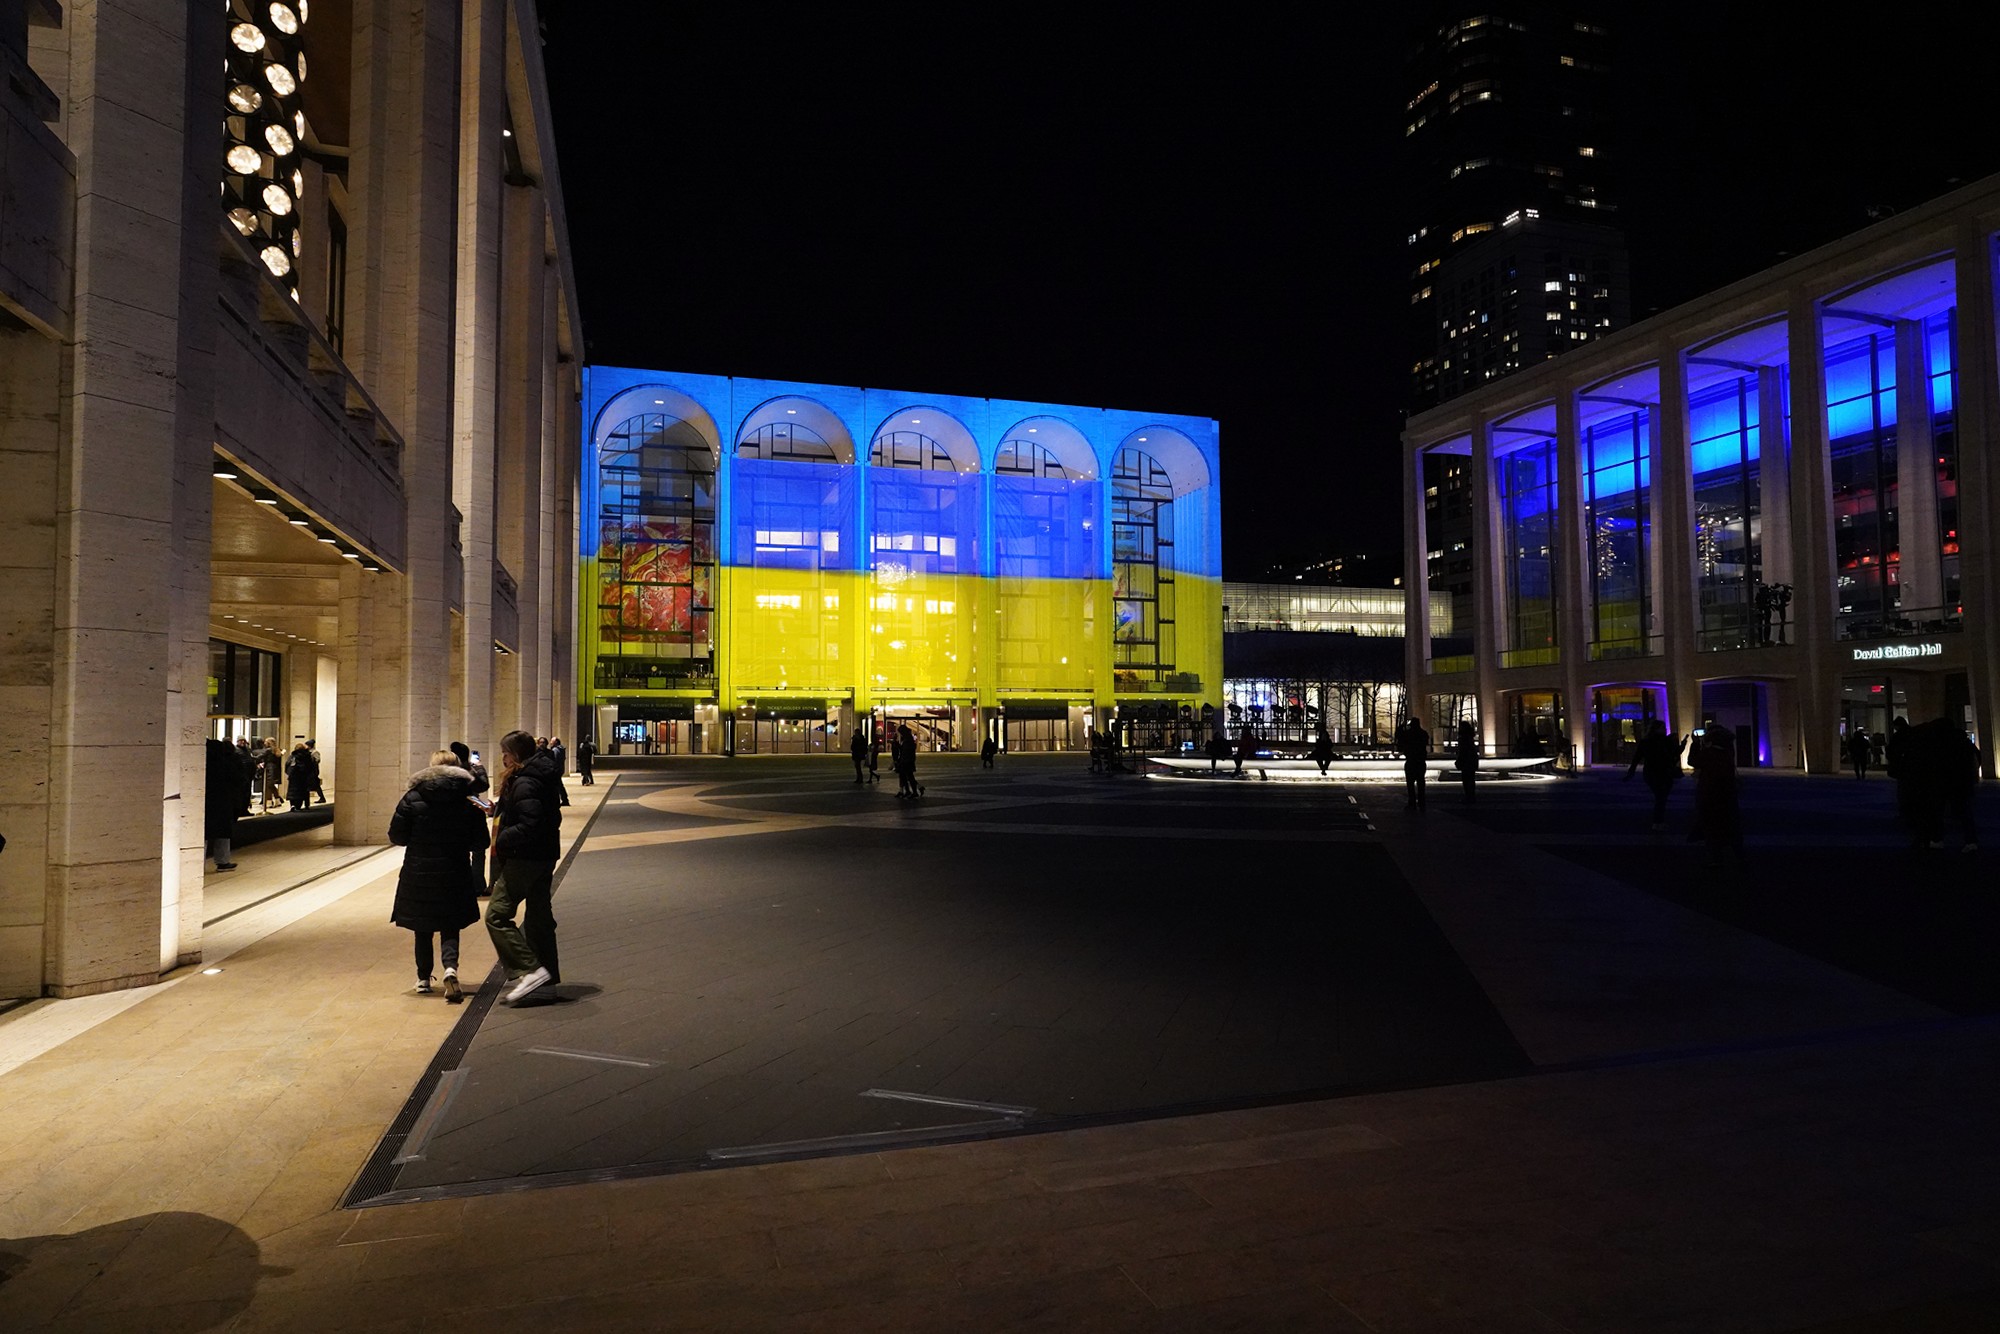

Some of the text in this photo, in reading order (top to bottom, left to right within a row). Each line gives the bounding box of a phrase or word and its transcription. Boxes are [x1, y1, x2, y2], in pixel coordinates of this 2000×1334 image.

[1853, 643, 1942, 660] David Geffen Hall
